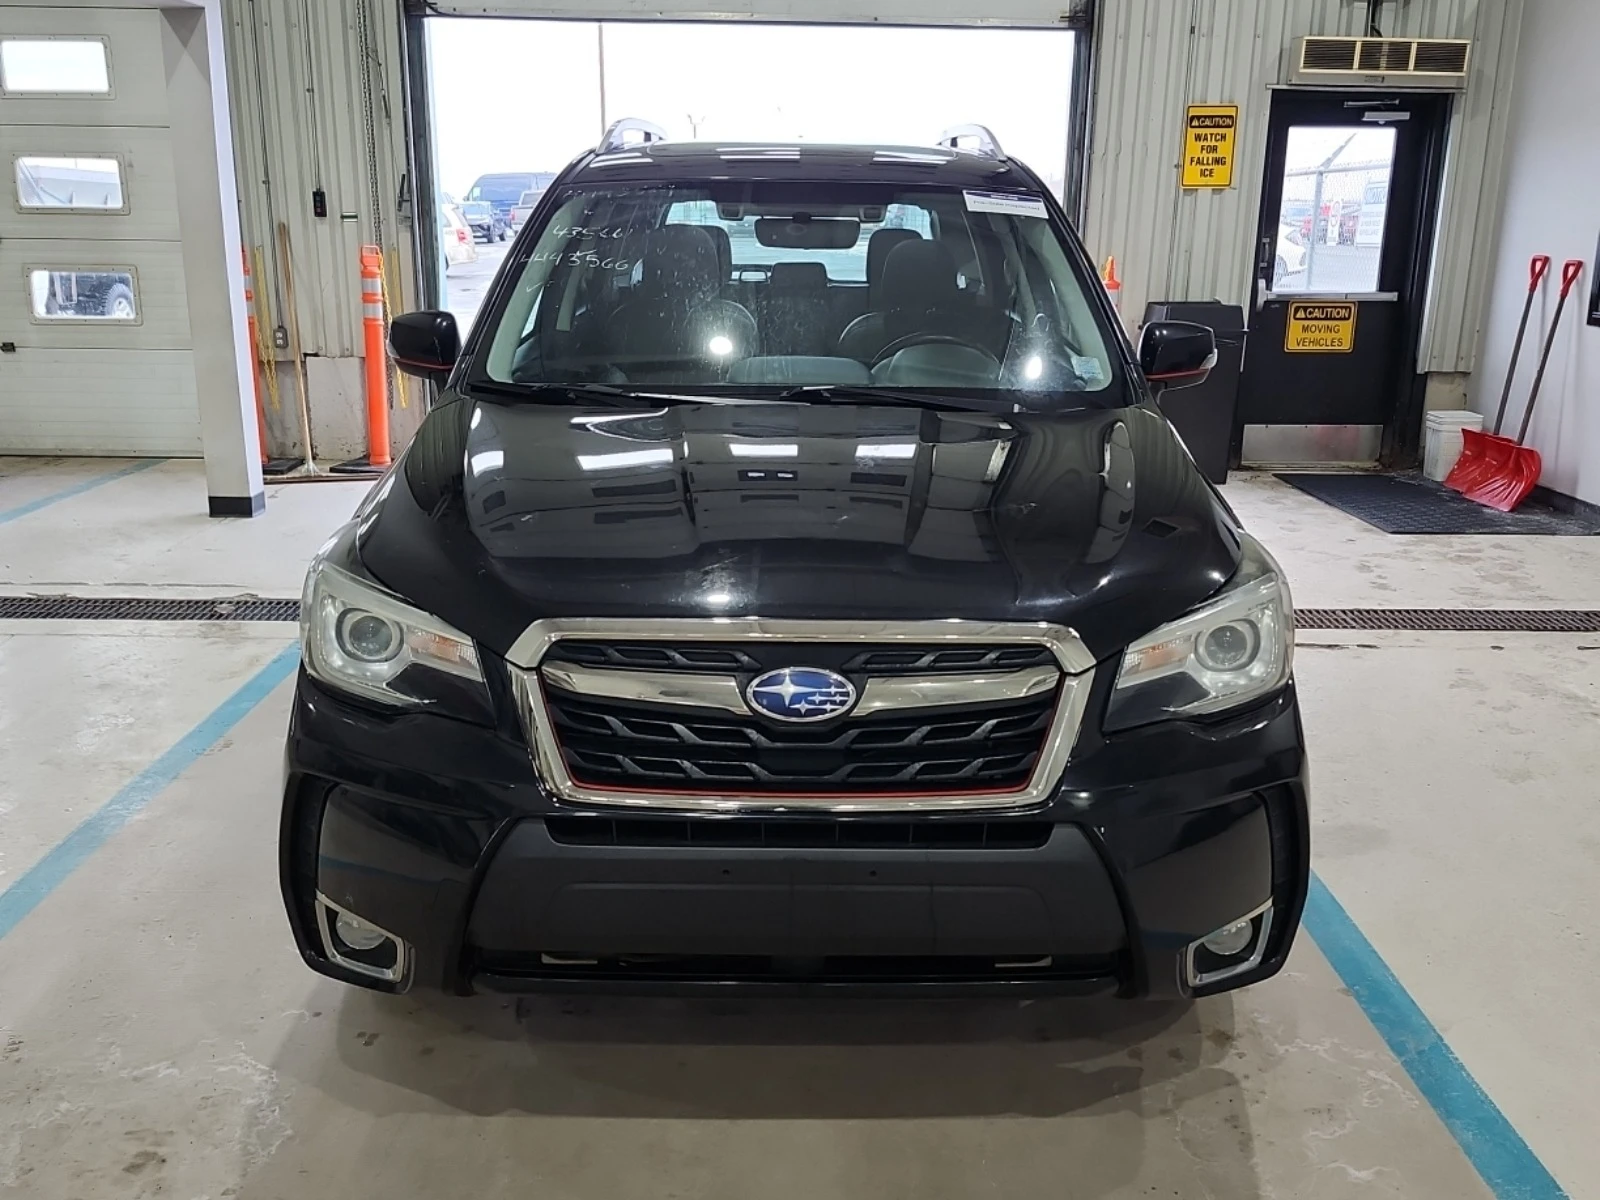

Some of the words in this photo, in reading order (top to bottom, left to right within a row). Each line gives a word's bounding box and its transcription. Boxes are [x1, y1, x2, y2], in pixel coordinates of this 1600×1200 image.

[1199, 117, 1232, 127] CAUTION
[1194, 132, 1227, 143] WATCH
[1200, 144, 1218, 154] FOR
[1189, 156, 1227, 167] FALLING
[1199, 168, 1215, 178] ICE
[1306, 307, 1350, 319] CAUTION
[1301, 323, 1341, 334] MOVING
[1296, 337, 1343, 347] VEHICLES
